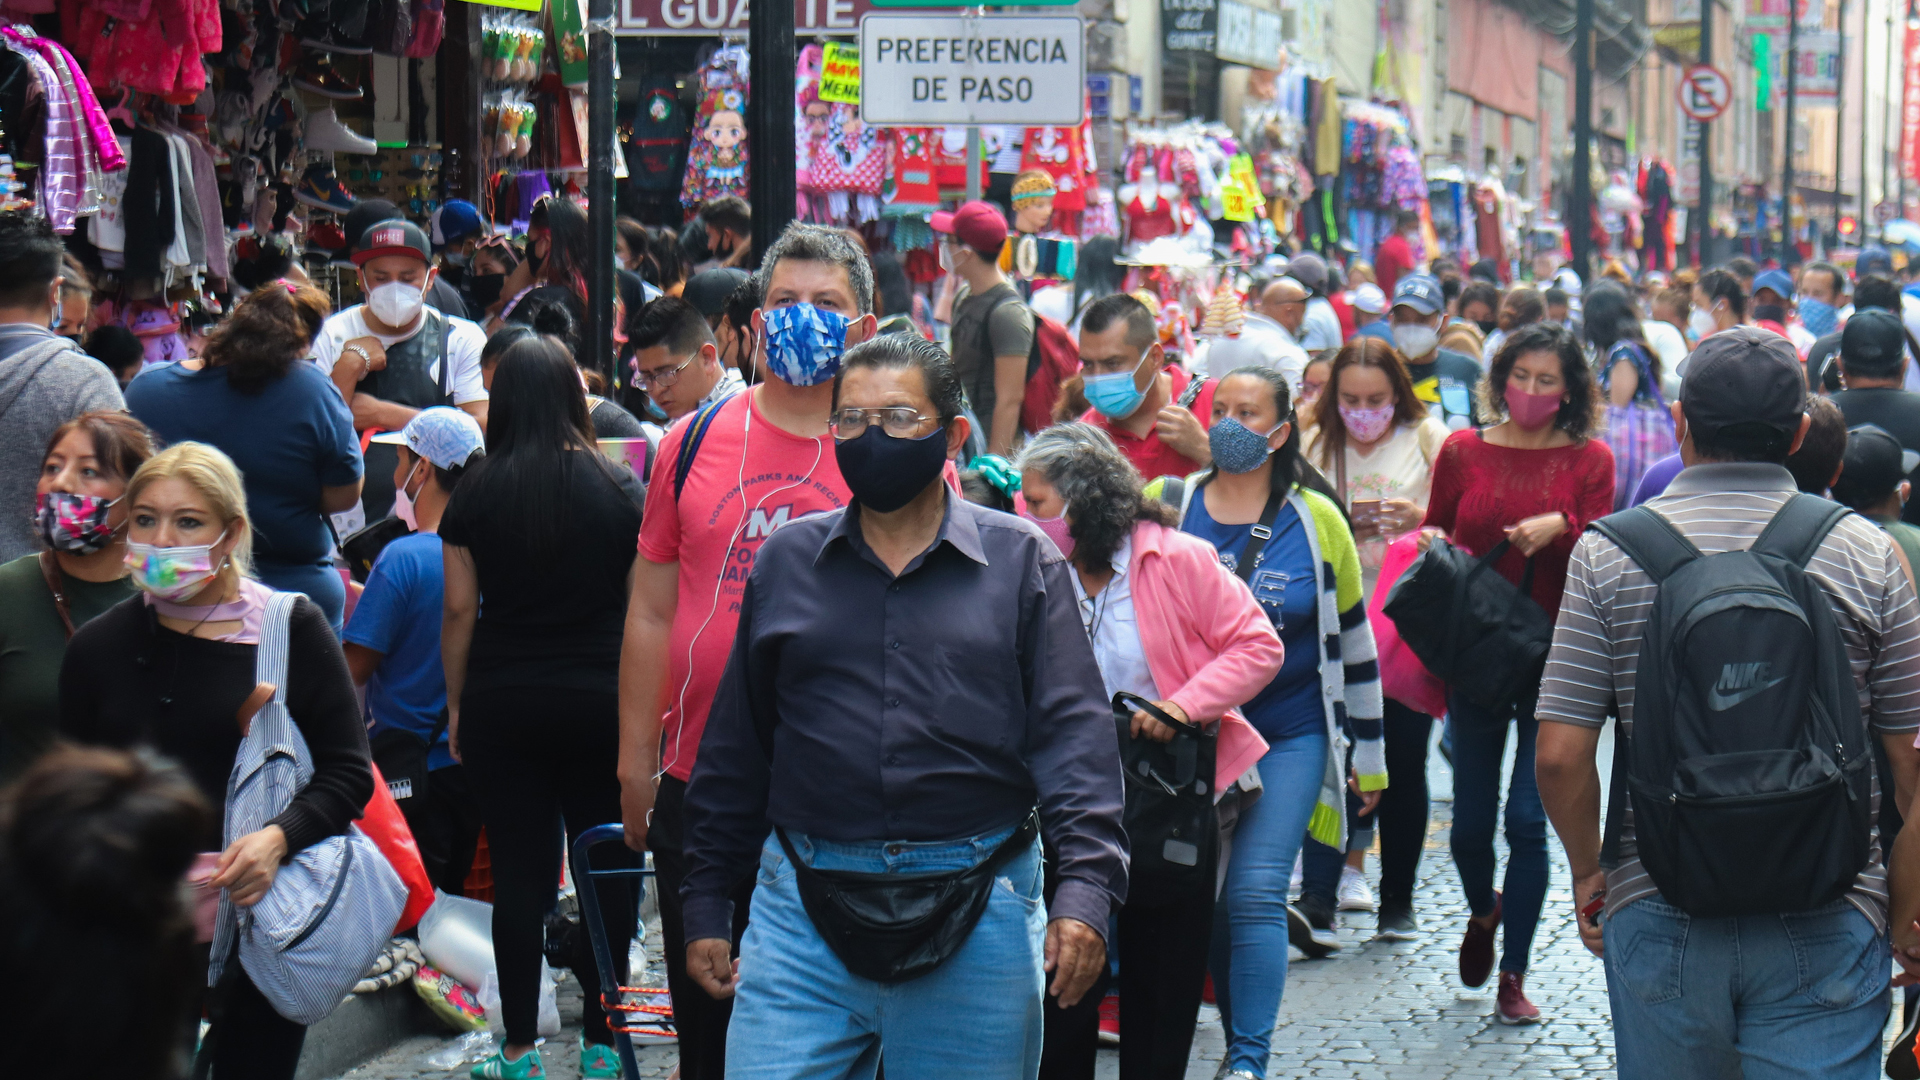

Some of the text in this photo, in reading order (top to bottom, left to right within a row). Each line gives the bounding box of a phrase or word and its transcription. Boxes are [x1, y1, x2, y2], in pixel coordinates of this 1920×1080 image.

[876, 38, 1067, 63] PREFERENCIA
[912, 77, 1033, 102] DE PASO
[709, 486, 742, 526] BOSTON
[744, 473, 782, 488] PARKS
[786, 474, 811, 485] AND
[1718, 662, 1771, 690] NIKE
